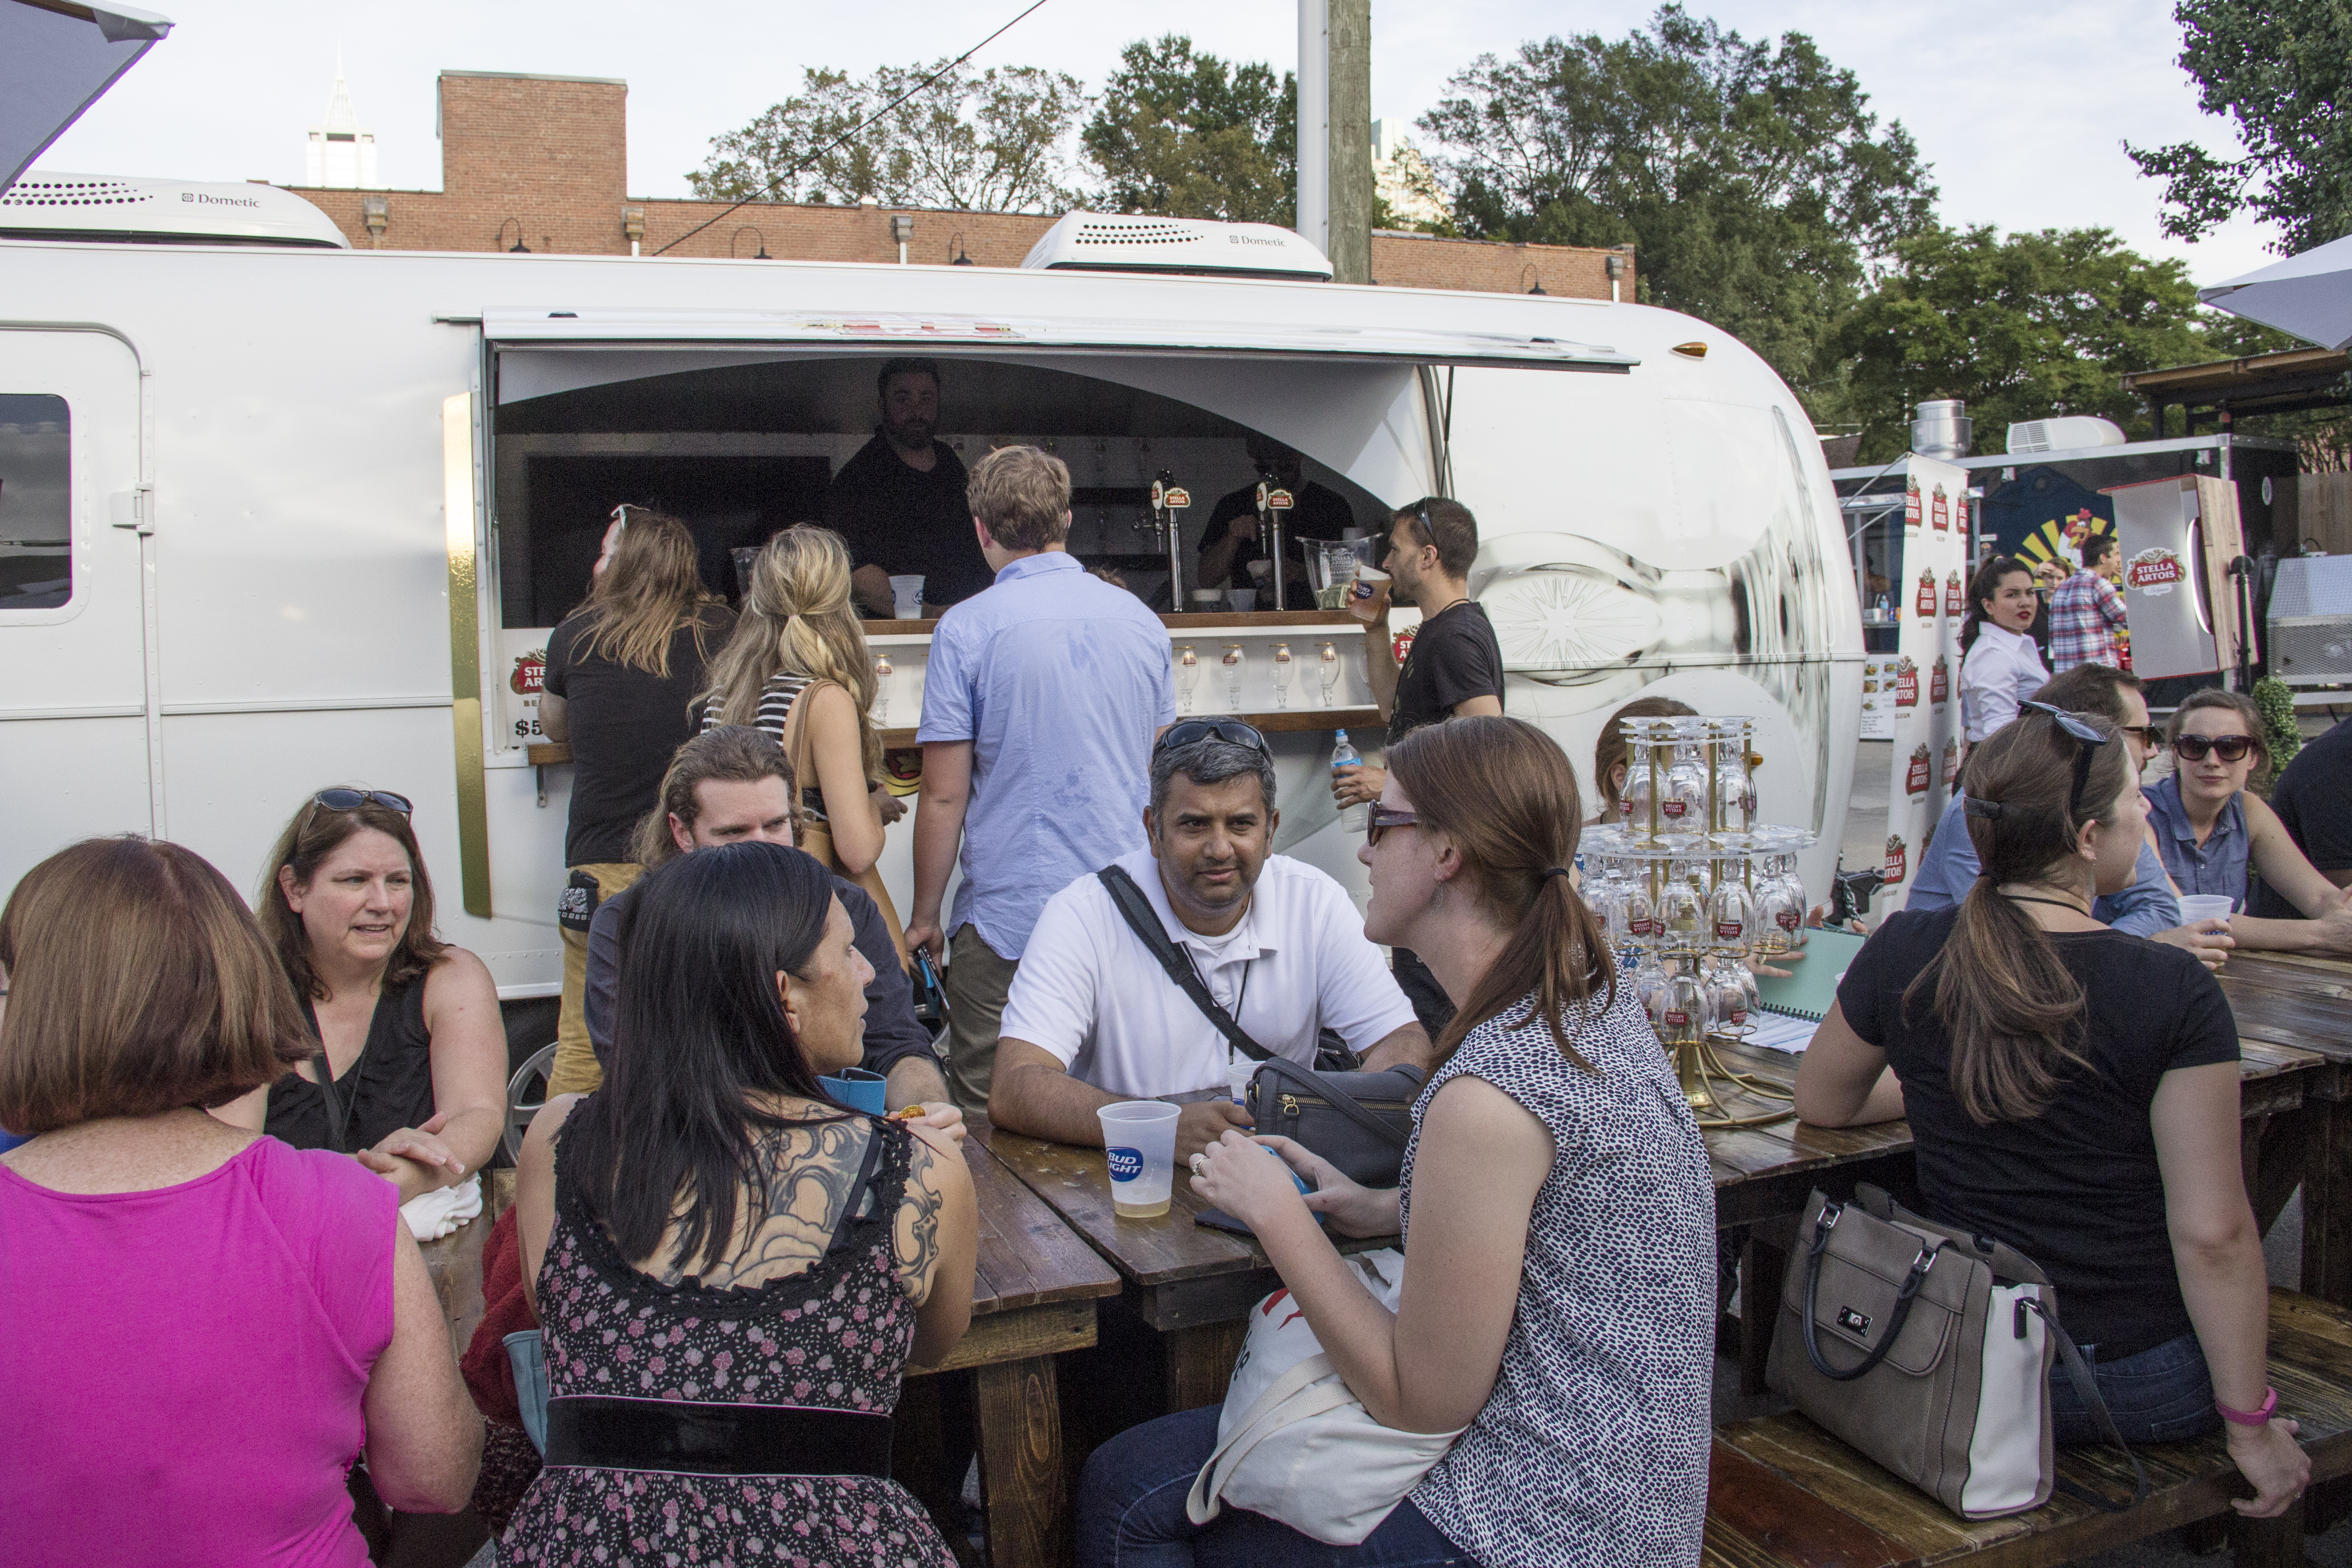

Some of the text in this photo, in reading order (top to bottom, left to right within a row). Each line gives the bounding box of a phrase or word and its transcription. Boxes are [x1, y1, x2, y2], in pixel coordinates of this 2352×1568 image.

[199, 194, 261, 208] Dometic
[1241, 235, 1286, 247] Dometic
[2136, 562, 2175, 574] STELLA
[2137, 570, 2176, 583] ARTOIS
[1896, 689, 1914, 700] RTOIS
[1108, 1152, 1137, 1164] BUD
